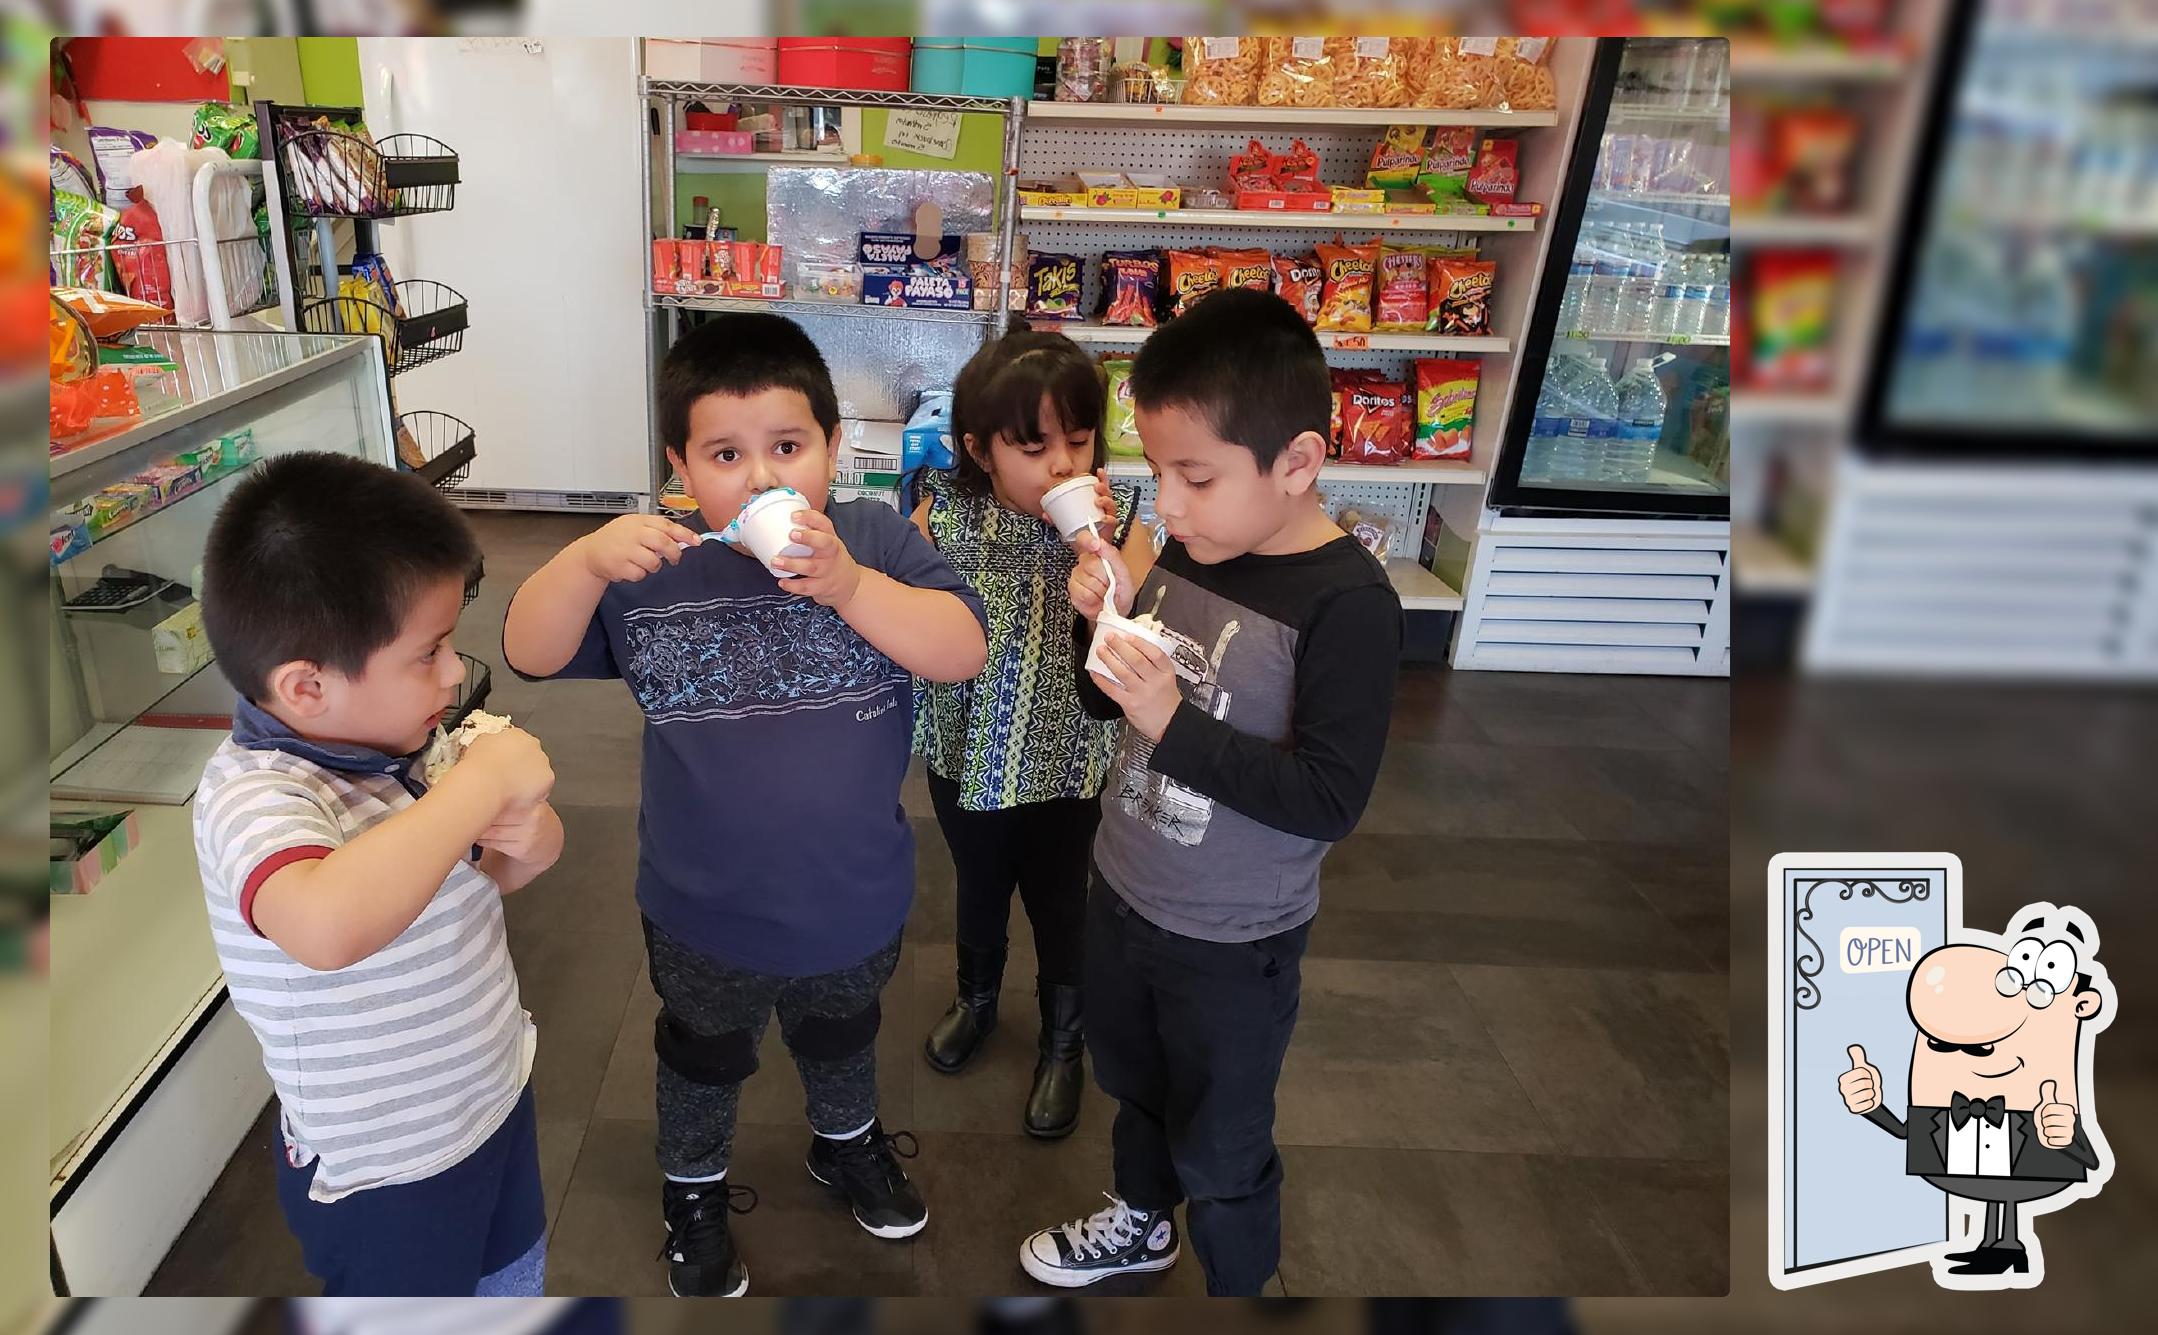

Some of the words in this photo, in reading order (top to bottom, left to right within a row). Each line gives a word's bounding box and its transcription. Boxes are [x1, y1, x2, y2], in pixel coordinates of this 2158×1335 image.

[1376, 155, 1420, 168] Pulparindo
[1427, 156, 1471, 172] Pulparindo
[1471, 180, 1514, 194] Pulparindo
[1108, 259, 1159, 273] TURBOS
[910, 276, 951, 288] PALETA
[904, 284, 954, 299] PAYASO
[1353, 394, 1395, 407] Doritos
[834, 471, 865, 485] ARROT
